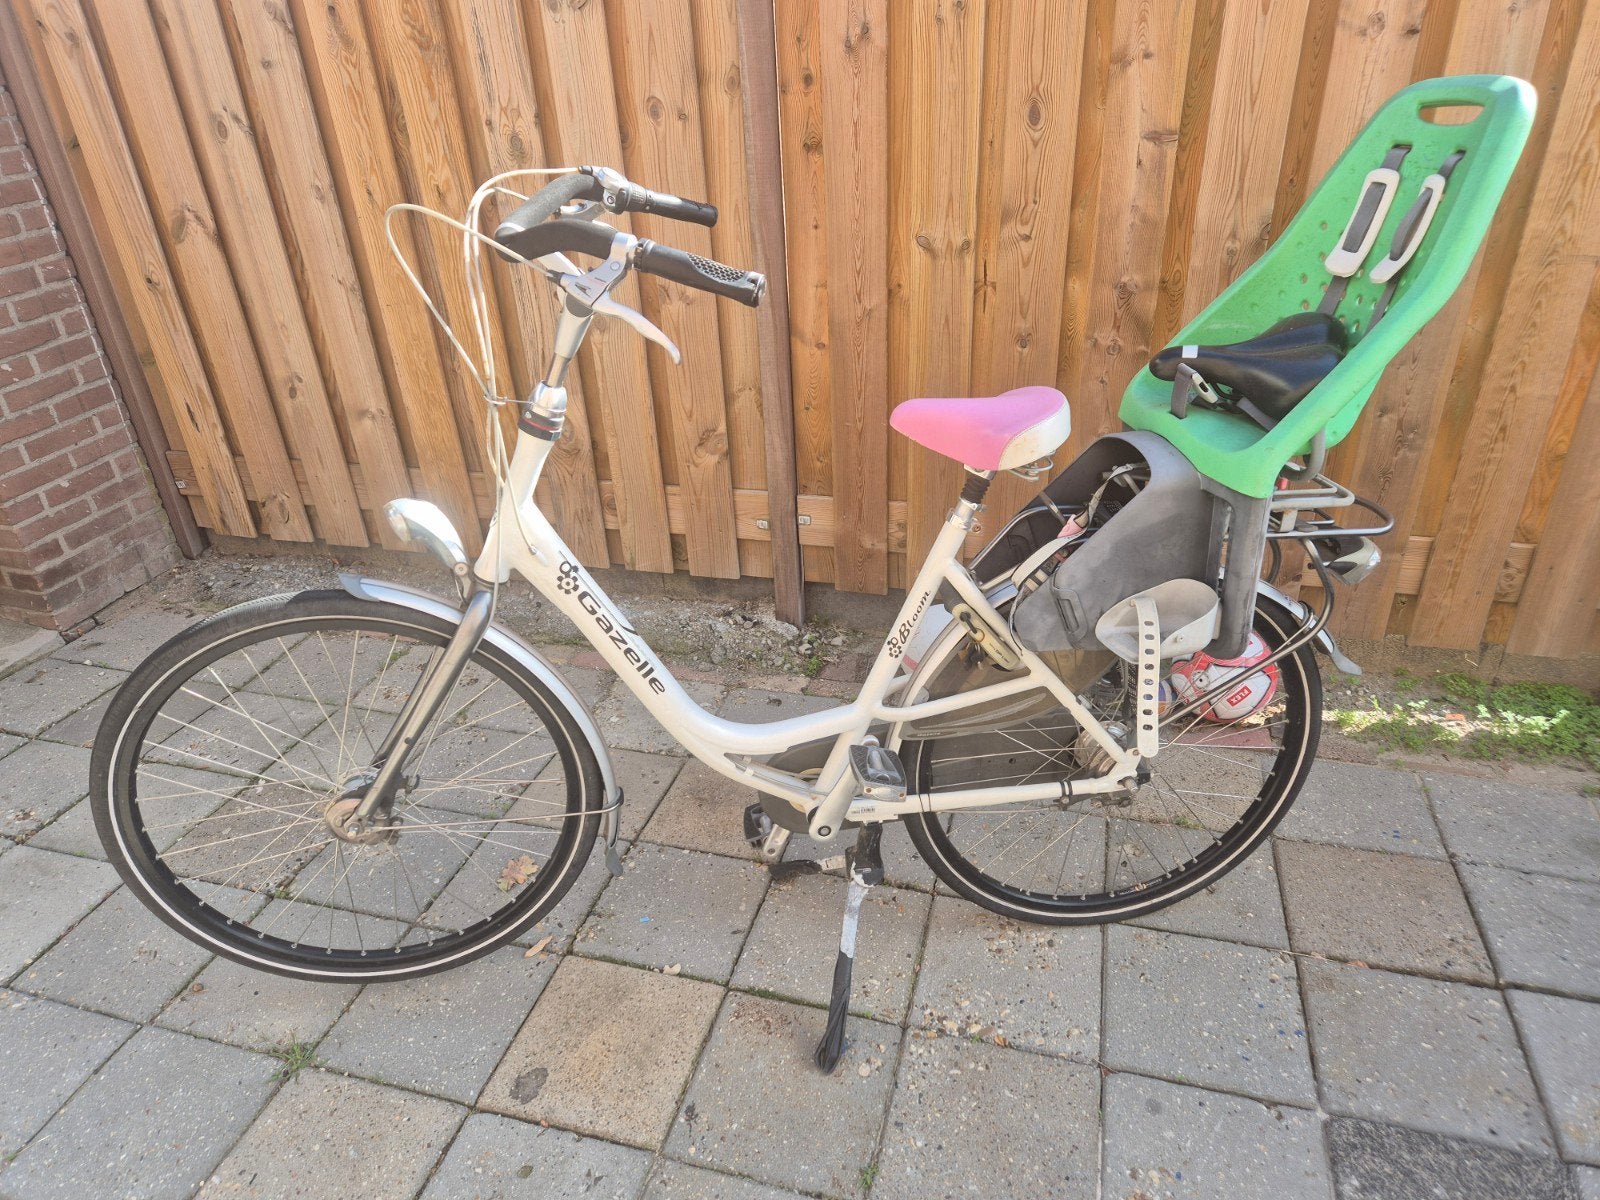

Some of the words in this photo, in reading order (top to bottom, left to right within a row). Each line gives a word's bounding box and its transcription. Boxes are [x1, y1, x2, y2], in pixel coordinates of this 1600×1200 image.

[577, 590, 666, 695] Gazelle
[898, 590, 931, 645] Bloom
[1229, 687, 1250, 705] FLEX
